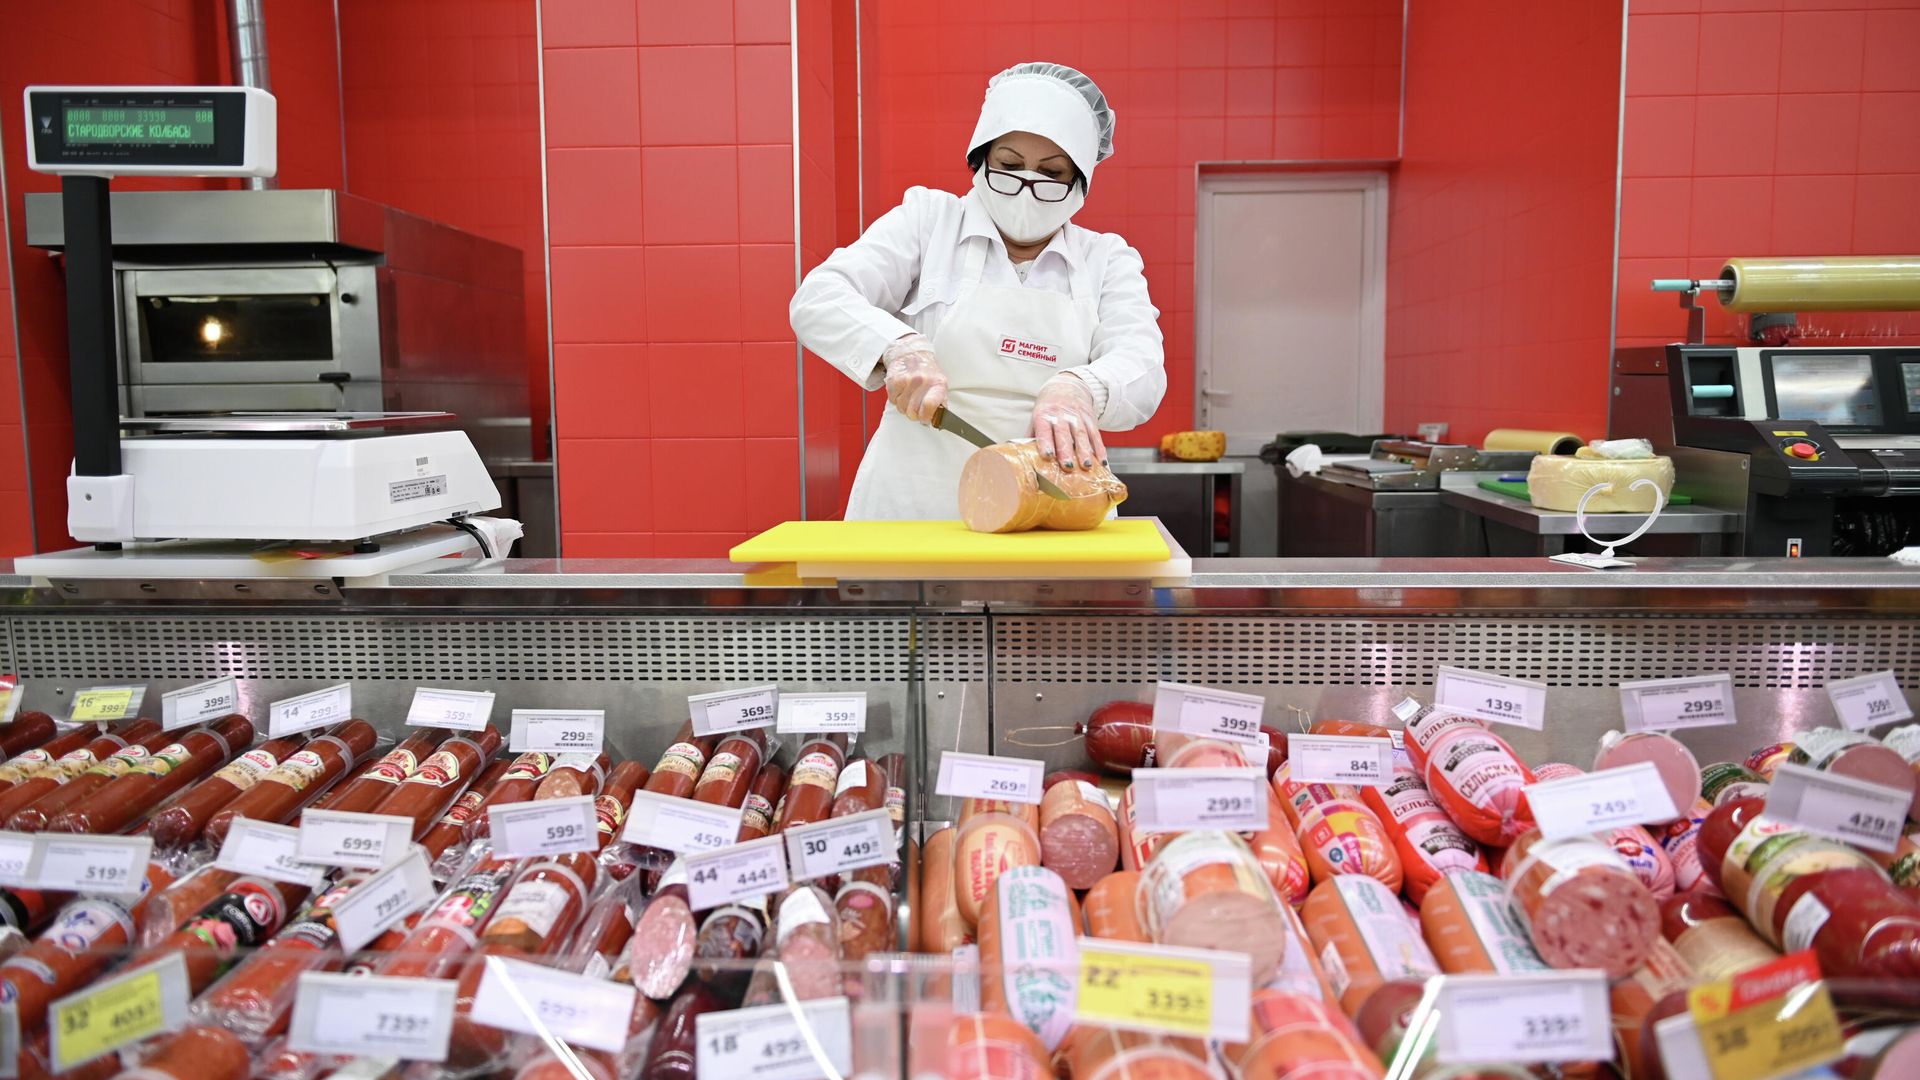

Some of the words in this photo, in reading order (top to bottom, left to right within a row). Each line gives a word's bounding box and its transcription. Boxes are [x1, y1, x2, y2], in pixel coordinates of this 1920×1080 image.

[68, 124, 144, 139] СТАРОДВОРСКИЕ
[149, 124, 191, 138] КОЛБАСЫ
[1018, 341, 1048, 352] МАГНИТ
[1017, 350, 1057, 362] СЕМЕЙНЫЙ
[80, 698, 93, 708] 16
[100, 704, 119, 714] 399
[204, 697, 224, 709] 399
[1486, 698, 1512, 712] 139
[1684, 700, 1713, 713] 299
[283, 707, 299, 719] 14
[310, 706, 331, 719] 299
[741, 705, 765, 718] 369
[825, 712, 848, 722] 359
[1220, 717, 1247, 731] 399
[561, 731, 585, 741] 299
[1350, 760, 1369, 771] 84
[990, 779, 1018, 792] 269
[1207, 797, 1242, 812] 299
[1393, 800, 1440, 818] СЕЛЬС
[1850, 812, 1886, 830] 429
[546, 825, 575, 840] 599
[342, 838, 372, 851] 699
[694, 832, 723, 847] 459
[805, 839, 827, 855] 30
[843, 843, 871, 858] 449
[86, 867, 117, 880] 519
[694, 867, 718, 884] 44
[737, 869, 768, 885] 444
